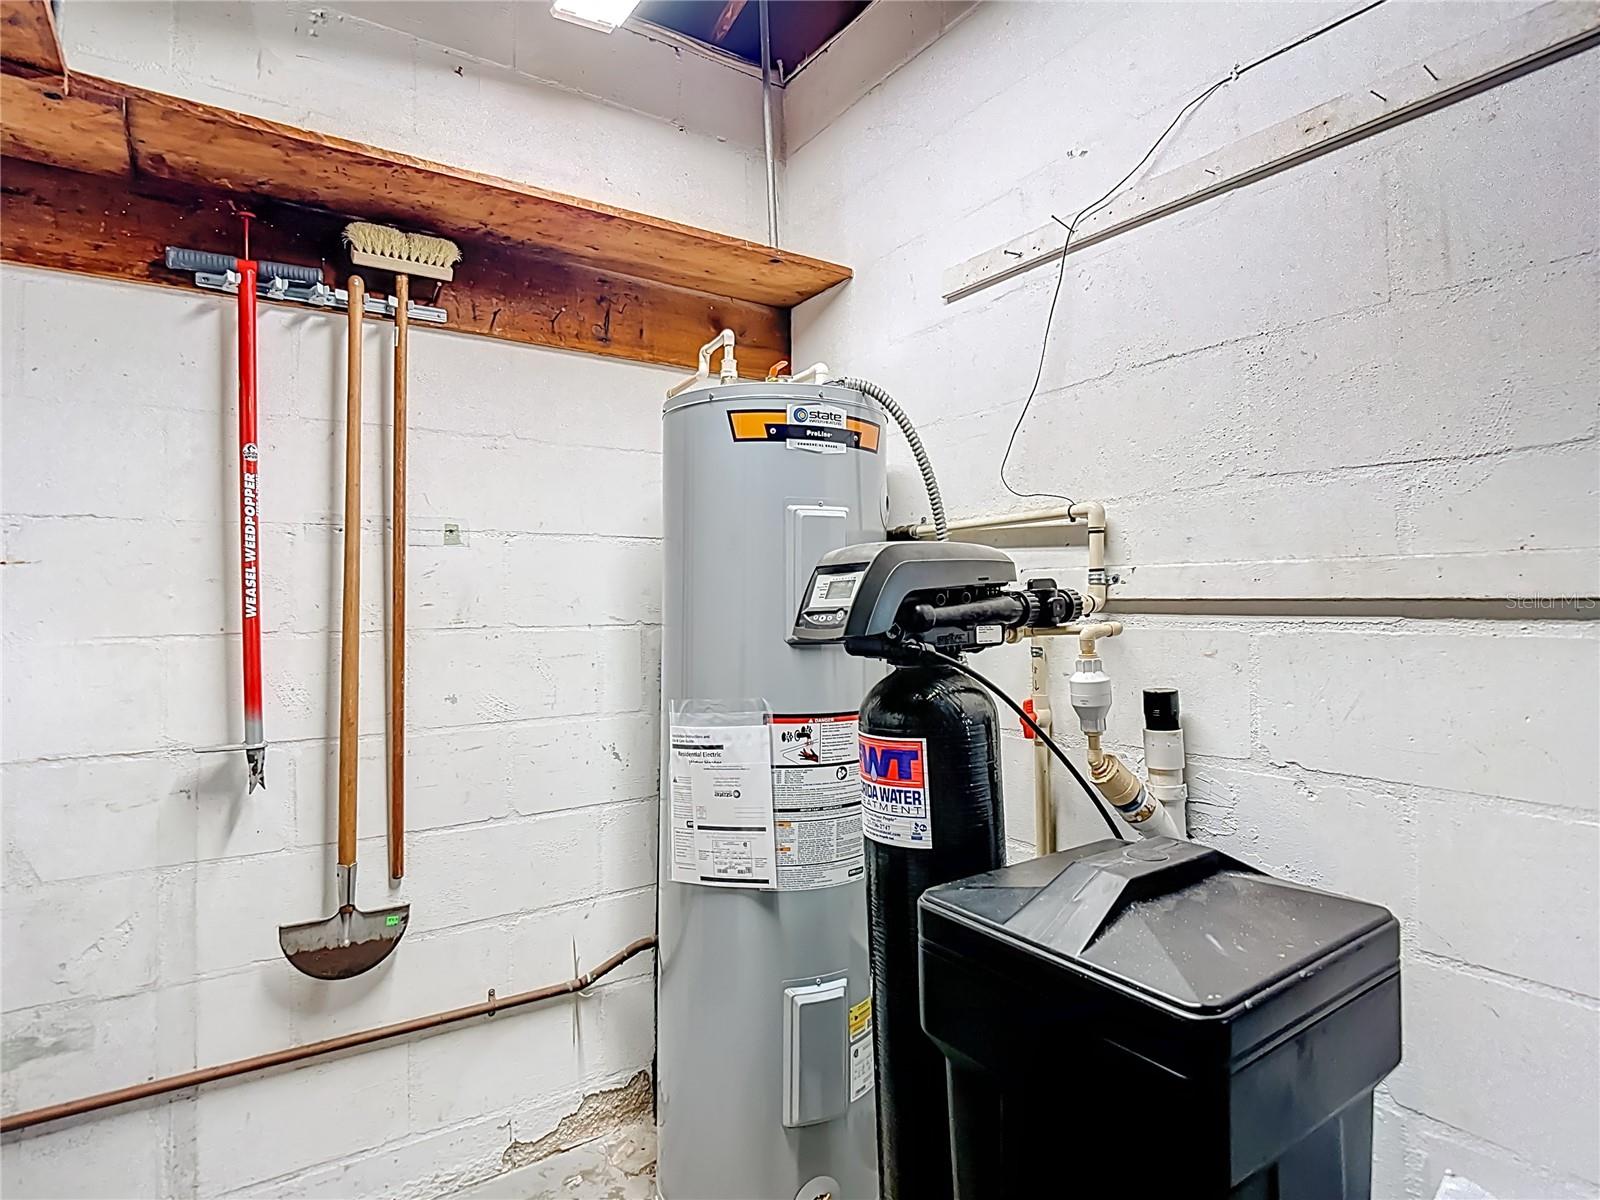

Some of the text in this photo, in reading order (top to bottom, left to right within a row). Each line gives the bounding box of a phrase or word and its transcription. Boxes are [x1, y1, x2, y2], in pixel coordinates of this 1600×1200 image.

[809, 411, 842, 422] state
[244, 472, 257, 562] WEEDPOPPER
[245, 566, 257, 618] WEASEL
[677, 750, 702, 758] Residential
[859, 742, 919, 780] WT
[879, 786, 922, 806] WATER
